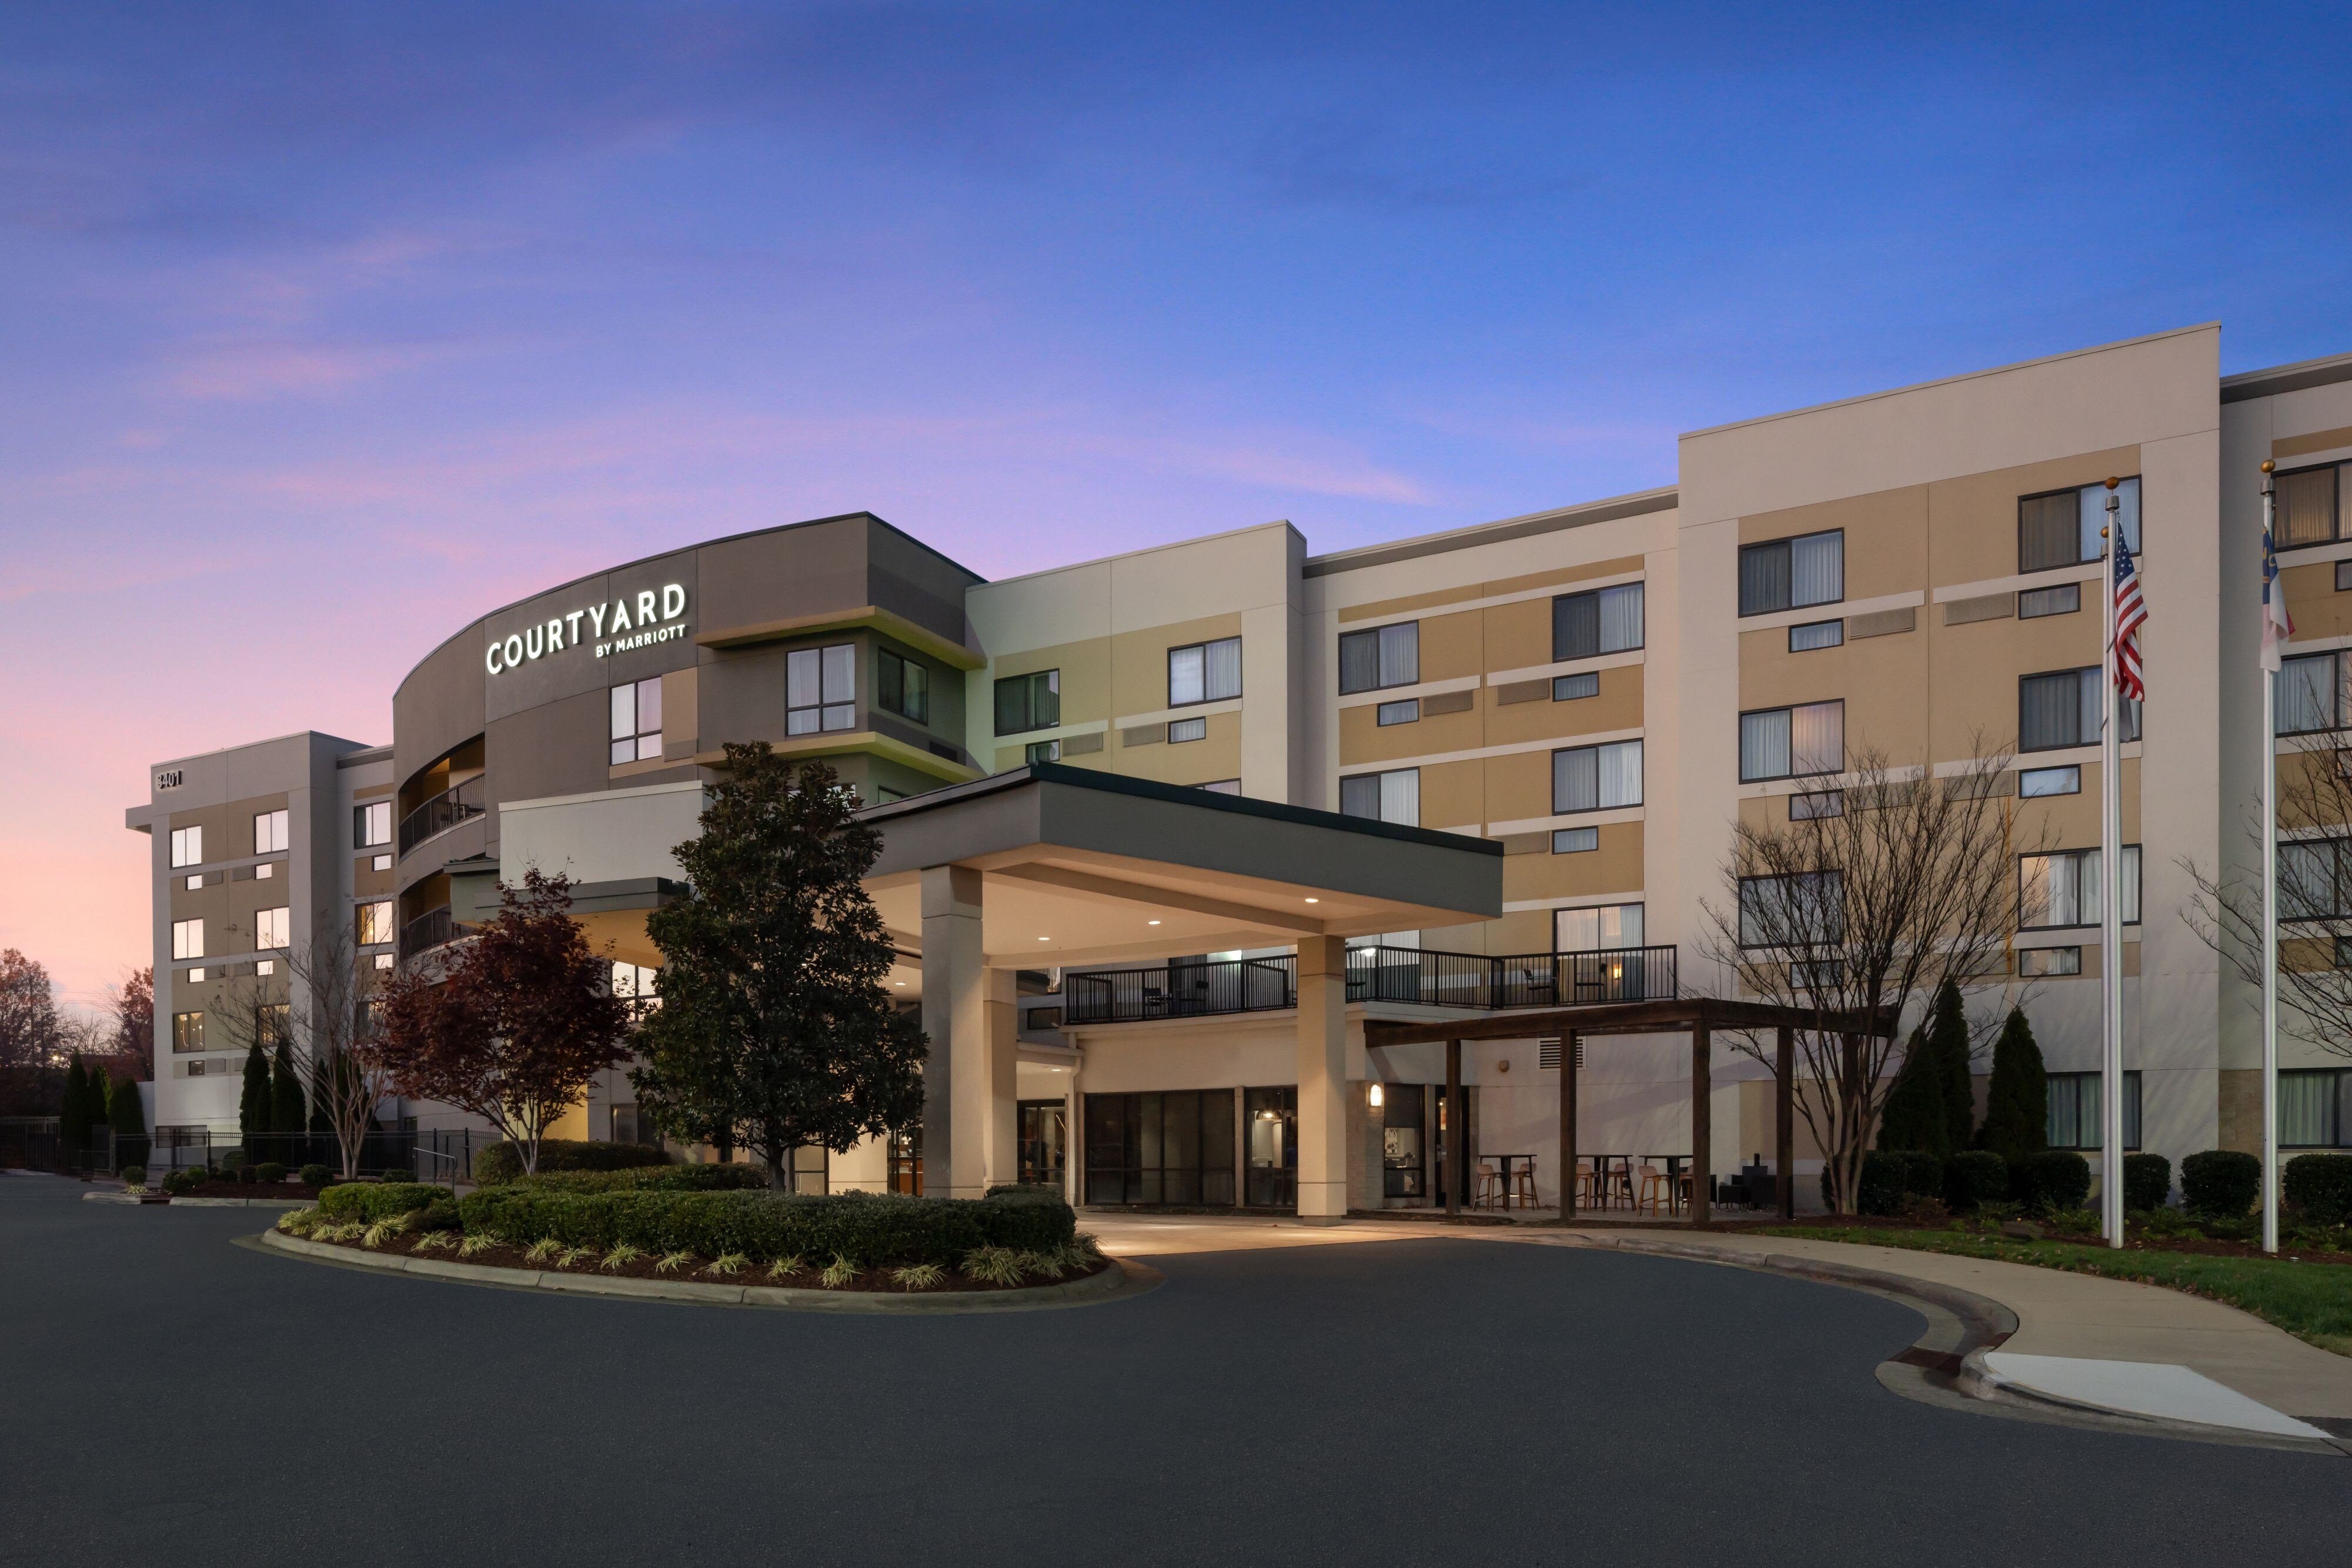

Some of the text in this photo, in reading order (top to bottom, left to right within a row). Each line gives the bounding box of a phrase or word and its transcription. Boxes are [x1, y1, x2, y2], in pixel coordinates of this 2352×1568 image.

[486, 584, 685, 675] COURTYARD
[596, 624, 685, 658] BY MARRIOTT
[156, 770, 179, 788] 3401
